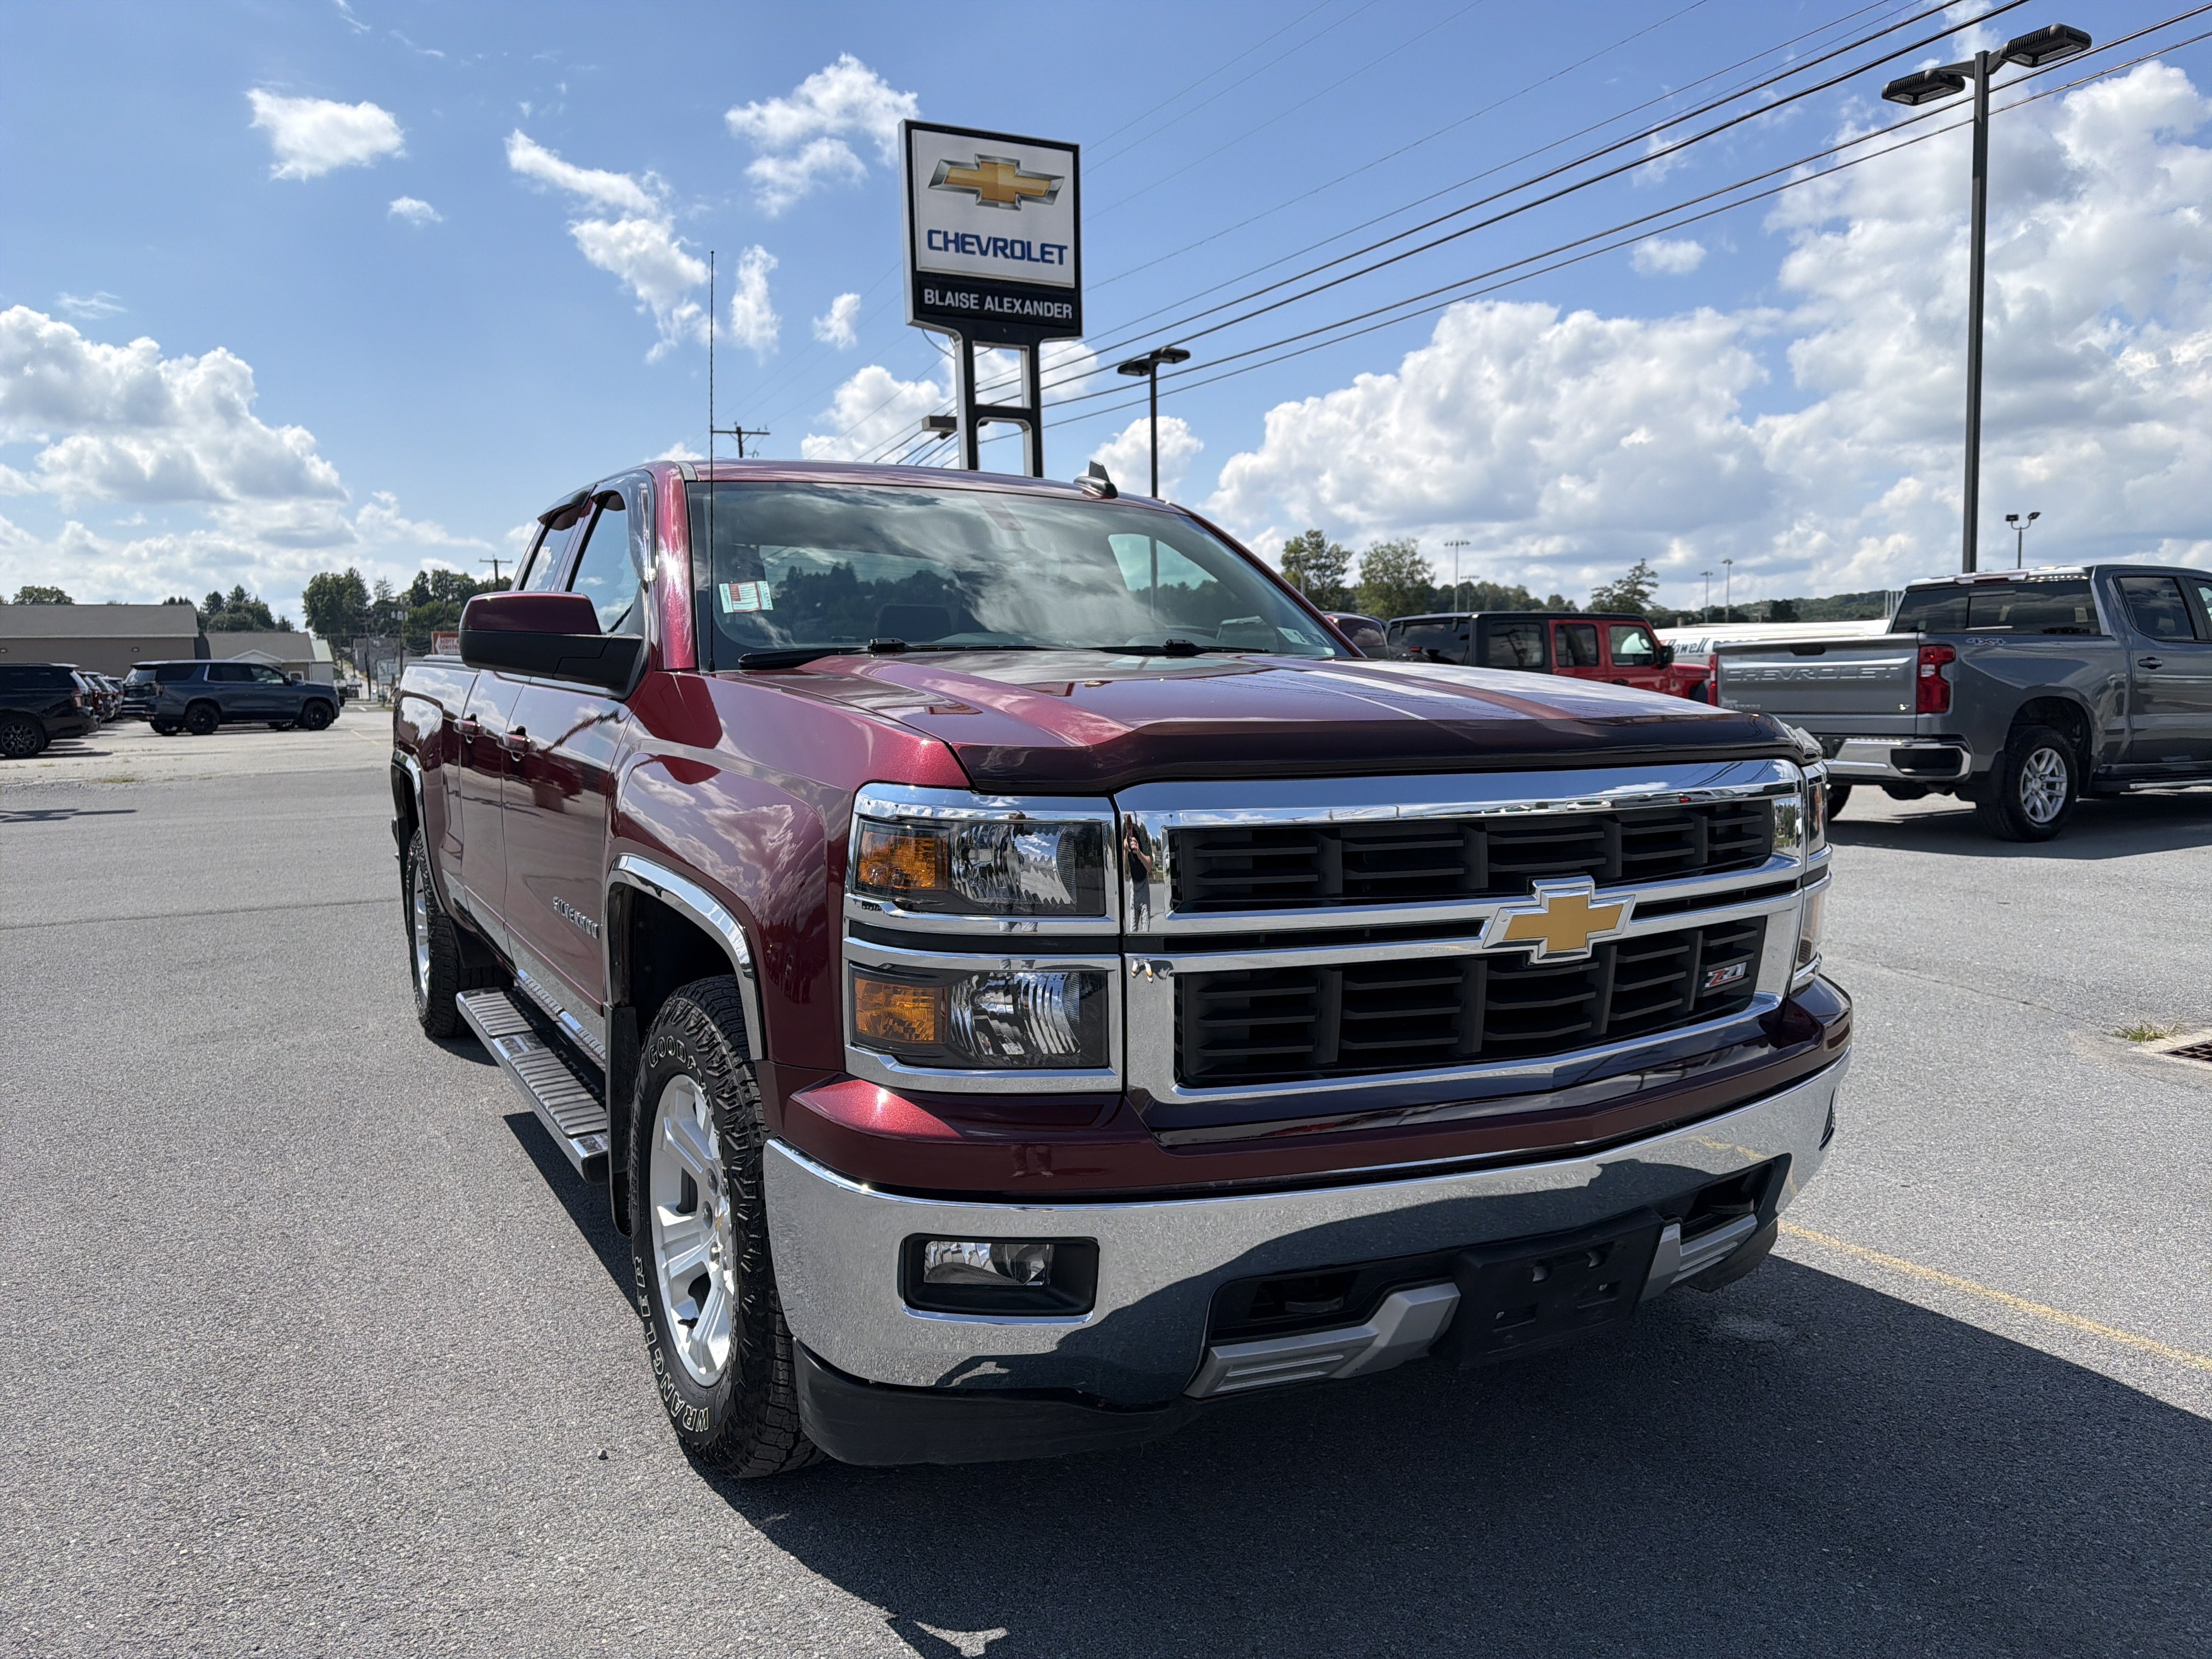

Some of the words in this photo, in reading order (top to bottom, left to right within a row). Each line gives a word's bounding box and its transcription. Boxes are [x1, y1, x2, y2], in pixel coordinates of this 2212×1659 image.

[927, 229, 1068, 266] CHEVROLET
[924, 287, 979, 310] BLAISE
[984, 295, 1073, 319] ALEXANDER
[1726, 666, 1899, 682] CHEVROLET
[1705, 962, 1747, 988] Z71
[634, 1255, 710, 1432] WRANGLER
